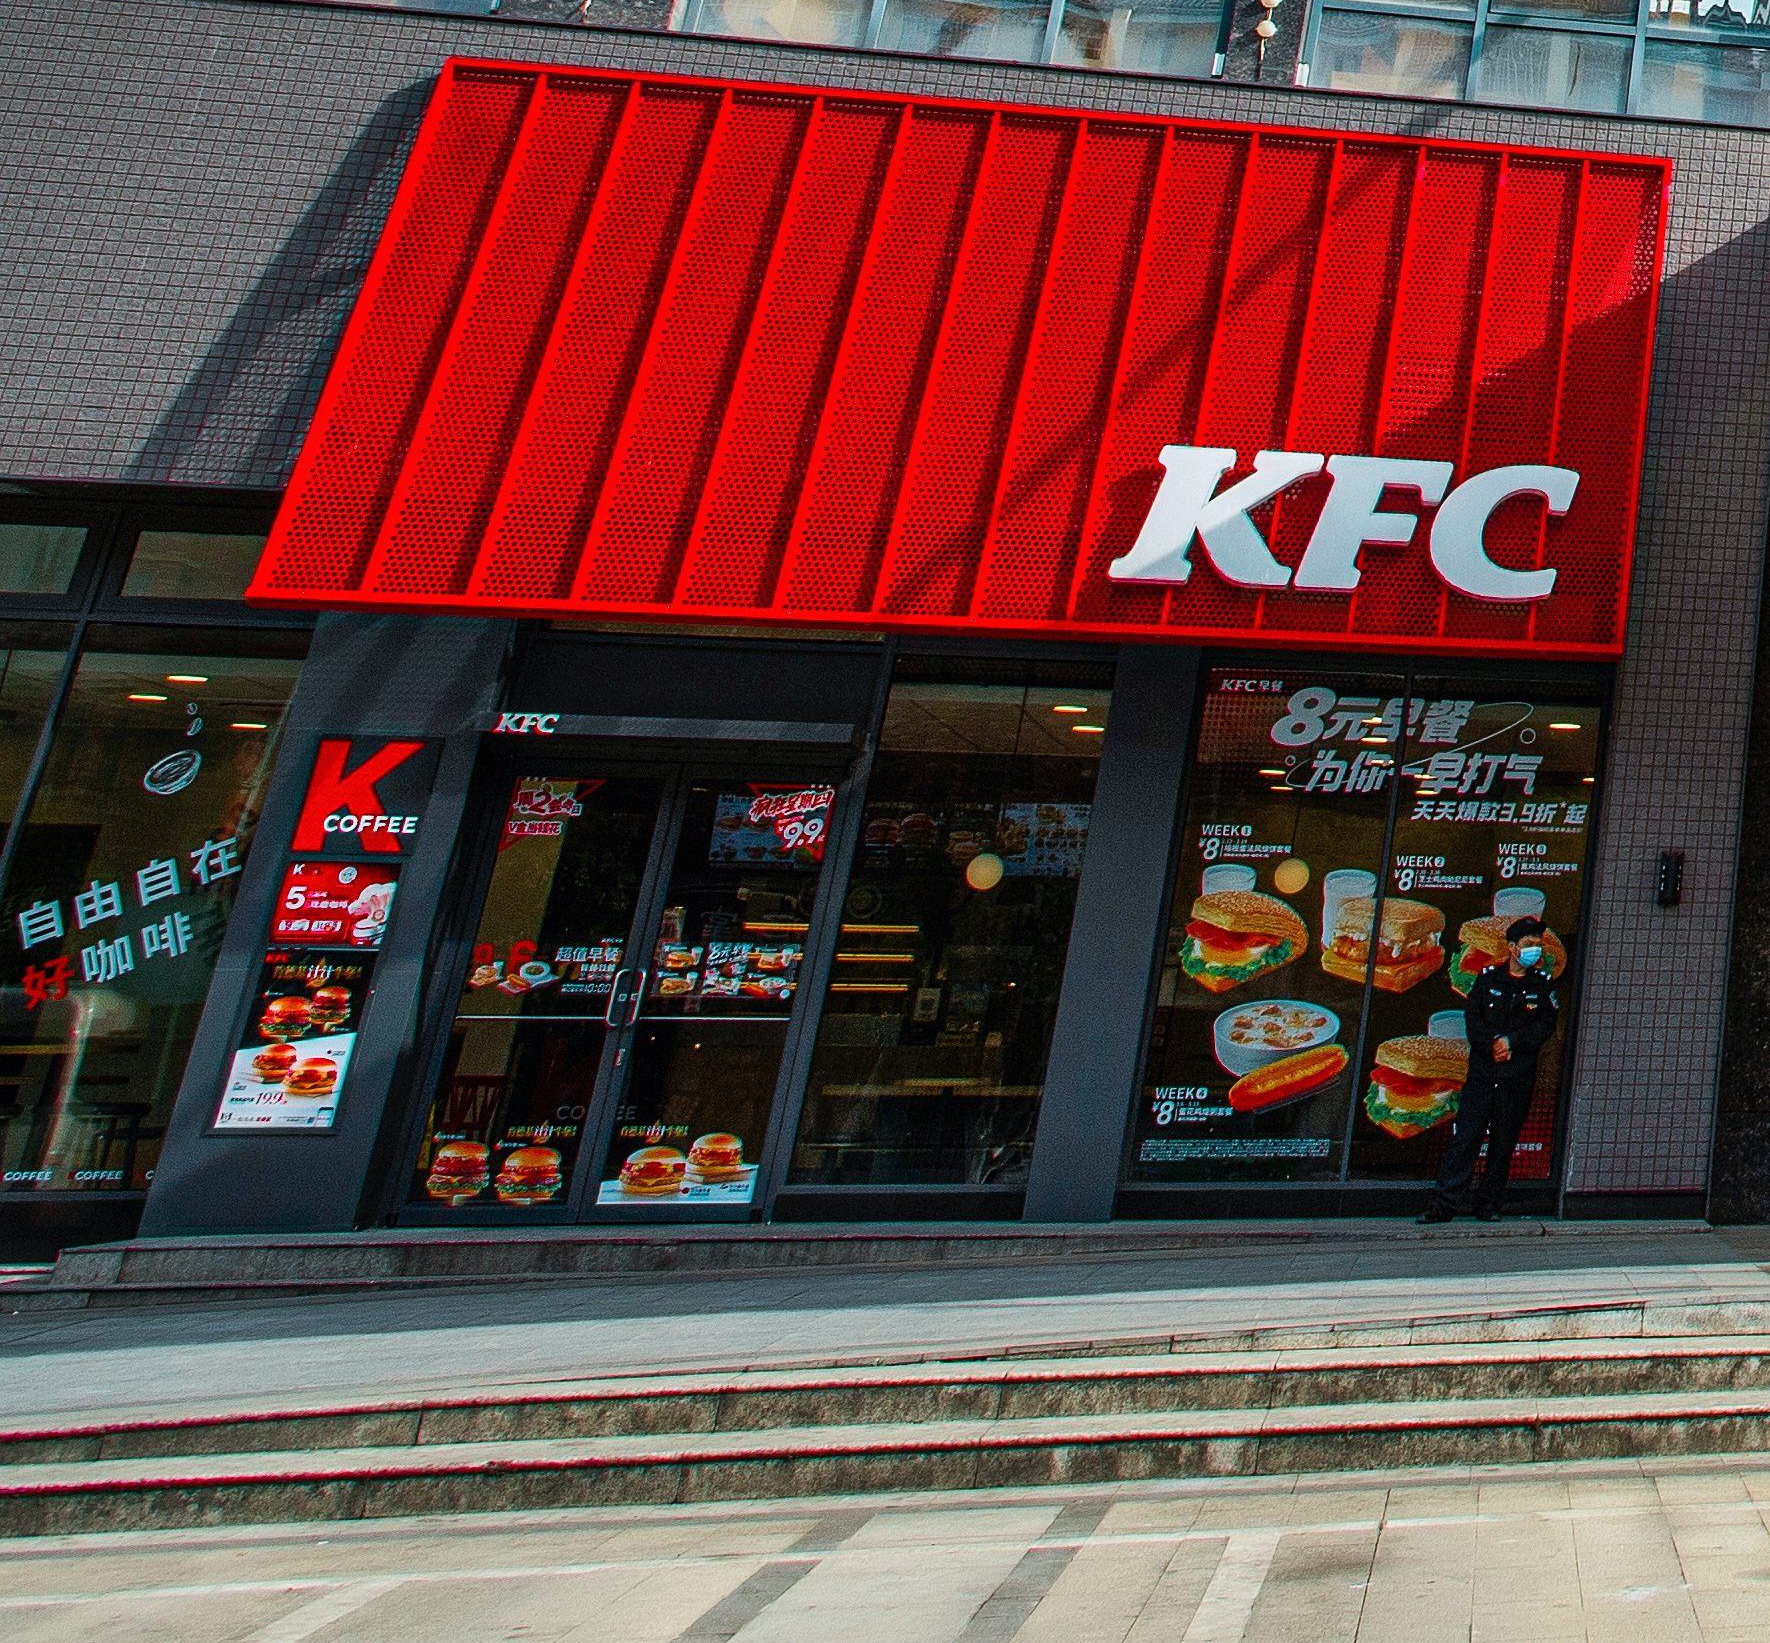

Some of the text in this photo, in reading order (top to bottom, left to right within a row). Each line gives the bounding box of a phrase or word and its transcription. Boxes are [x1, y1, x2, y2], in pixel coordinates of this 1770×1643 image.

[1108, 444, 1580, 603] KFC
[492, 712, 560, 735] KFC
[1270, 686, 1475, 747] 8元早餐
[1305, 749, 1544, 795] 为你一早打气
[291, 739, 425, 853] K
[323, 815, 418, 834] COFFEE
[1201, 824, 1241, 837] WEEK
[1498, 843, 1535, 856] WEEK
[1396, 855, 1434, 868] WEEK
[16, 837, 242, 950] 自由自在
[22, 911, 194, 1010] 好咖啡
[1155, 1087, 1195, 1100] WEEK
[556, 1105, 638, 1120] COEE
[3, 1170, 53, 1182] COFFEE
[74, 1170, 124, 1182] COFFEE
